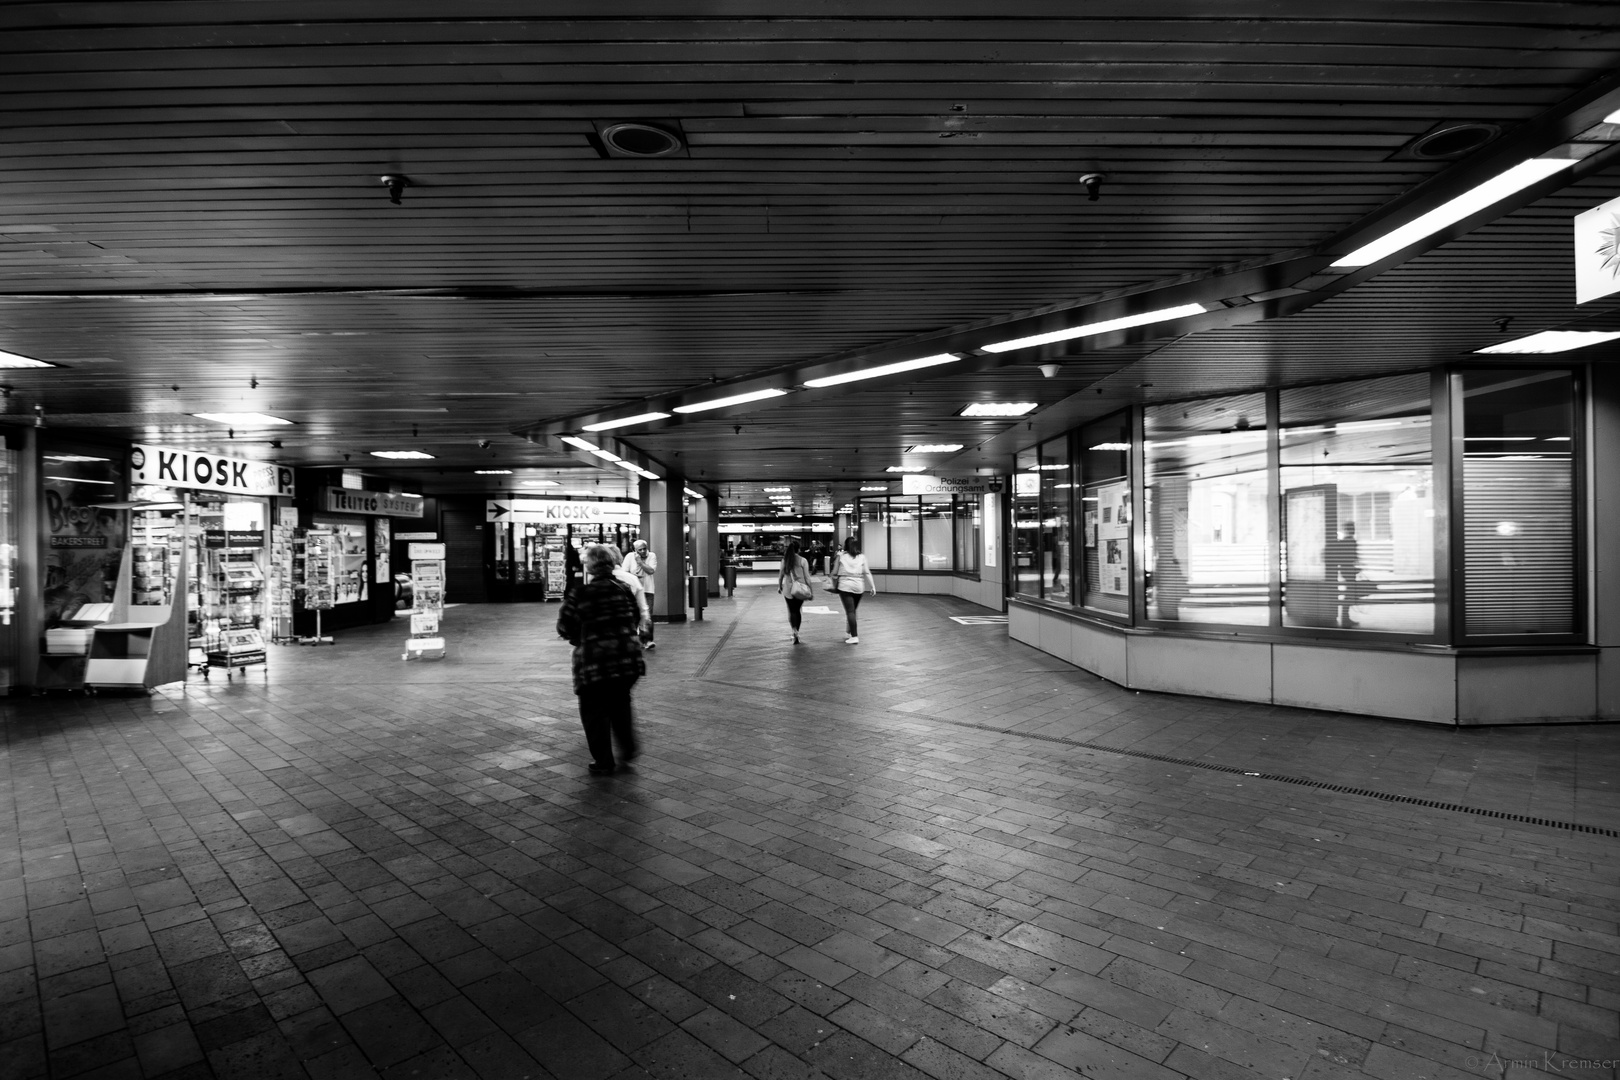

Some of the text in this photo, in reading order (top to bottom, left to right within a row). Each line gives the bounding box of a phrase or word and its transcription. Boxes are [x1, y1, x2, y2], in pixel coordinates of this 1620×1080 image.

[159, 451, 248, 488] KIOSK
[940, 477, 969, 485] Polizei
[925, 484, 985, 493] Ordnungsamt
[332, 489, 378, 511] TELITEC
[546, 505, 590, 519] KIOSK
[51, 537, 105, 546] BAKERSTREET
